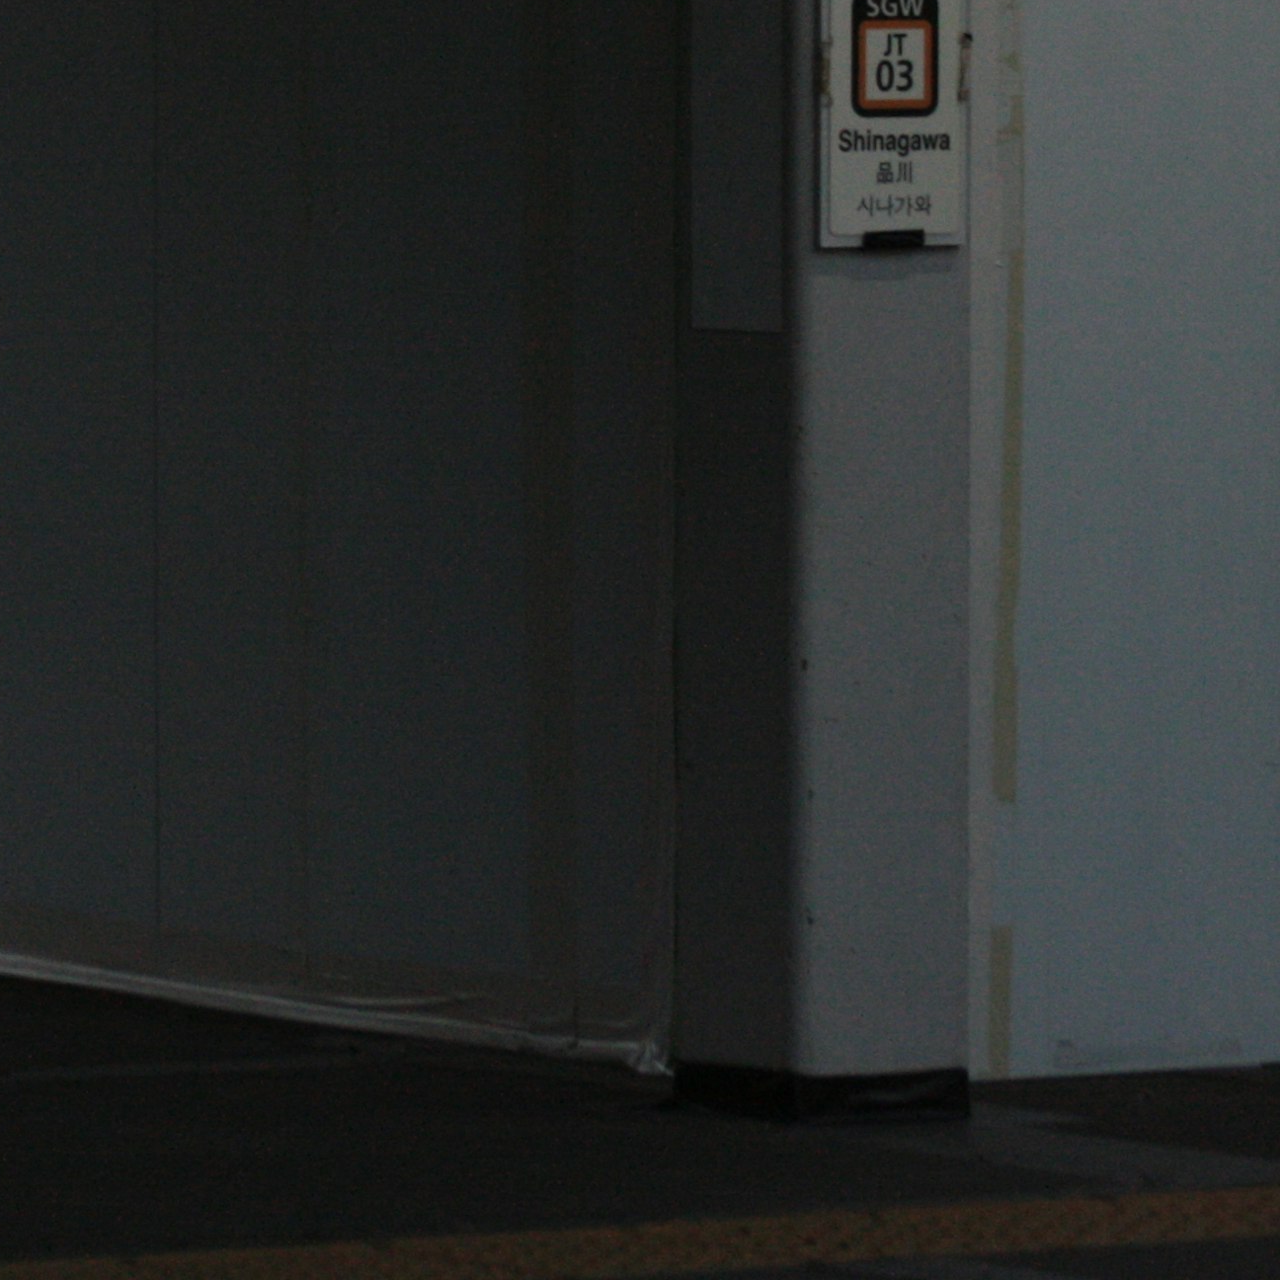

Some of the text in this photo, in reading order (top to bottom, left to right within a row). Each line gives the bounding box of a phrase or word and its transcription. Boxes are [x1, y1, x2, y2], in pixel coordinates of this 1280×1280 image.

[883, 33, 907, 57] JT
[876, 59, 914, 92] 03
[839, 130, 950, 155] Shinagawa
[877, 162, 912, 183] 品川
